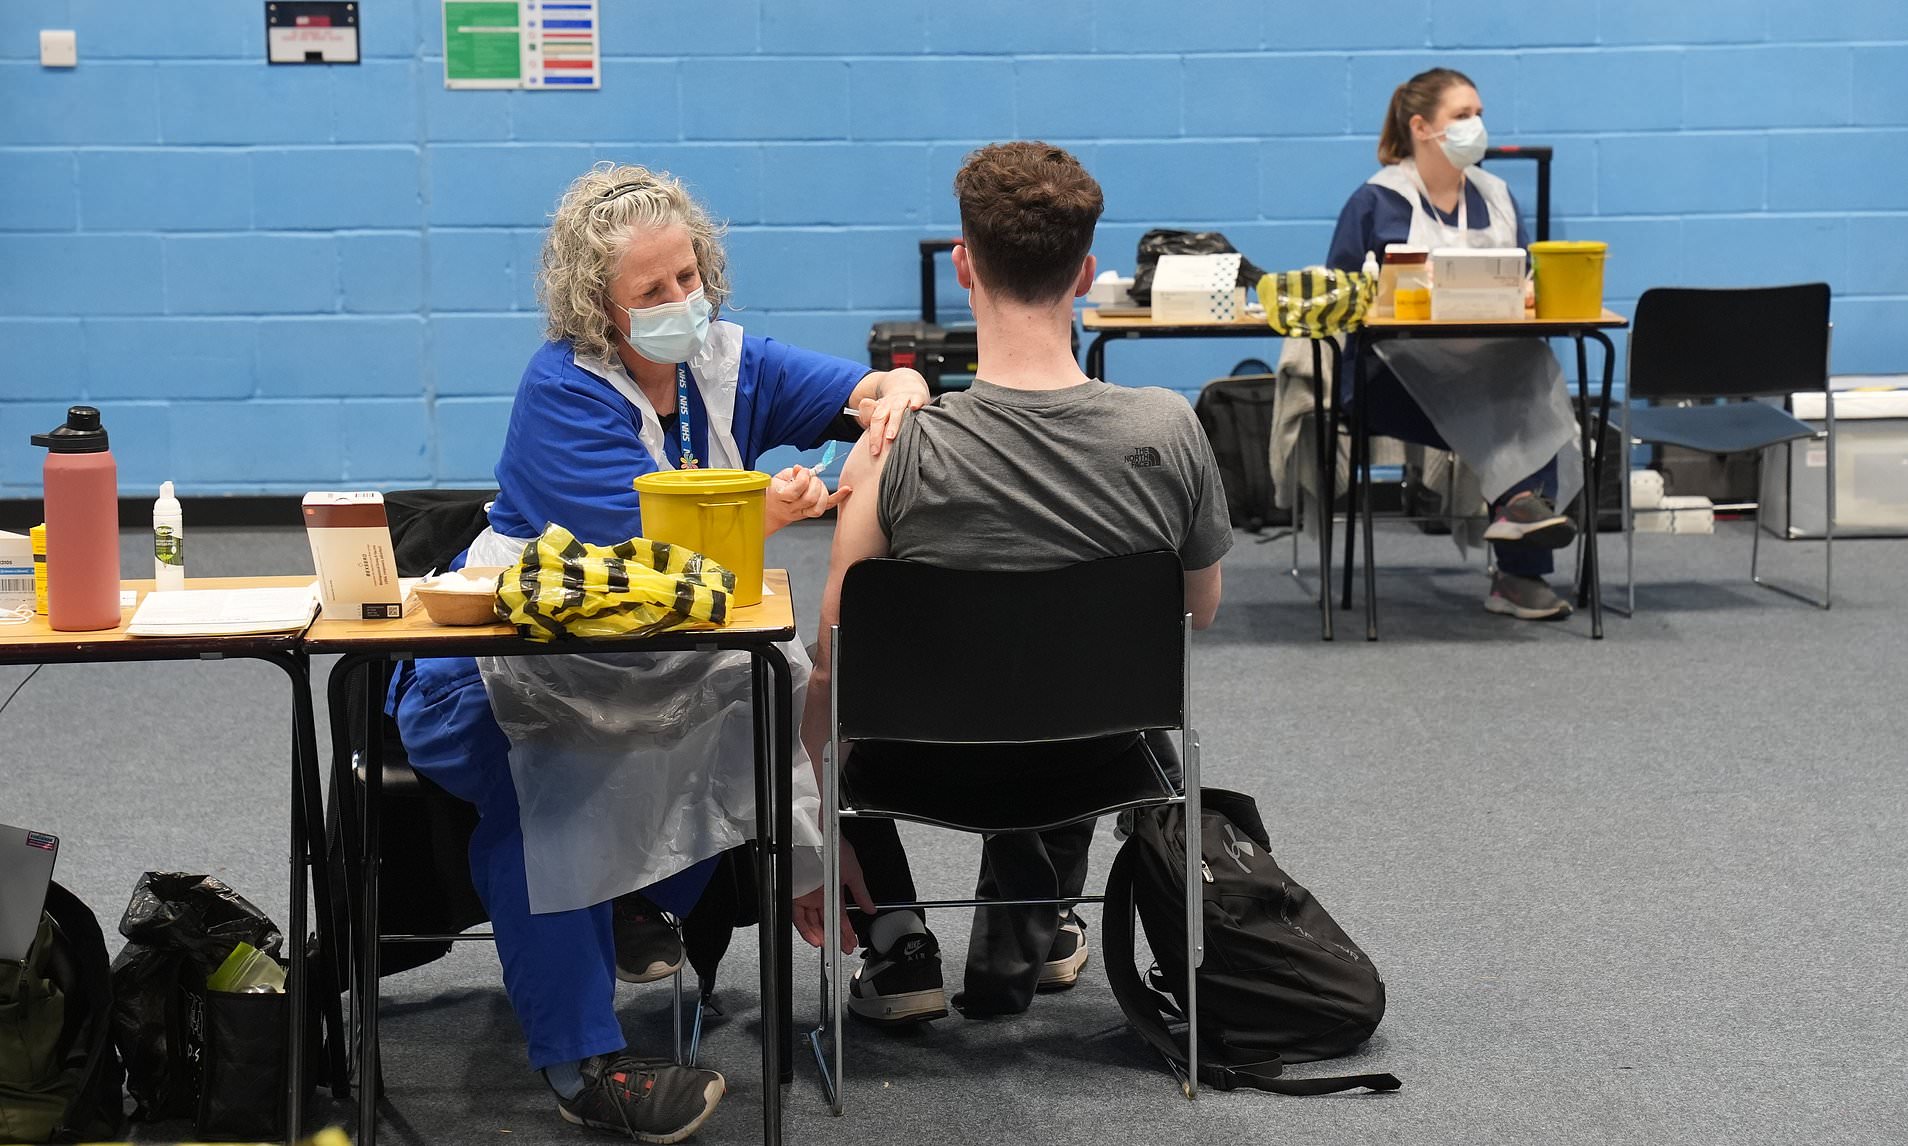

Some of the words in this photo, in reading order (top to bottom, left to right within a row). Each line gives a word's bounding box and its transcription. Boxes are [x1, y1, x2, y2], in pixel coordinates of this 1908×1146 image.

[680, 395, 688, 415] NHS
[682, 422, 690, 442] NHS
[1124, 454, 1149, 463] NORTH
[907, 940, 920, 950] NIKE
[908, 953, 925, 961] AIR
